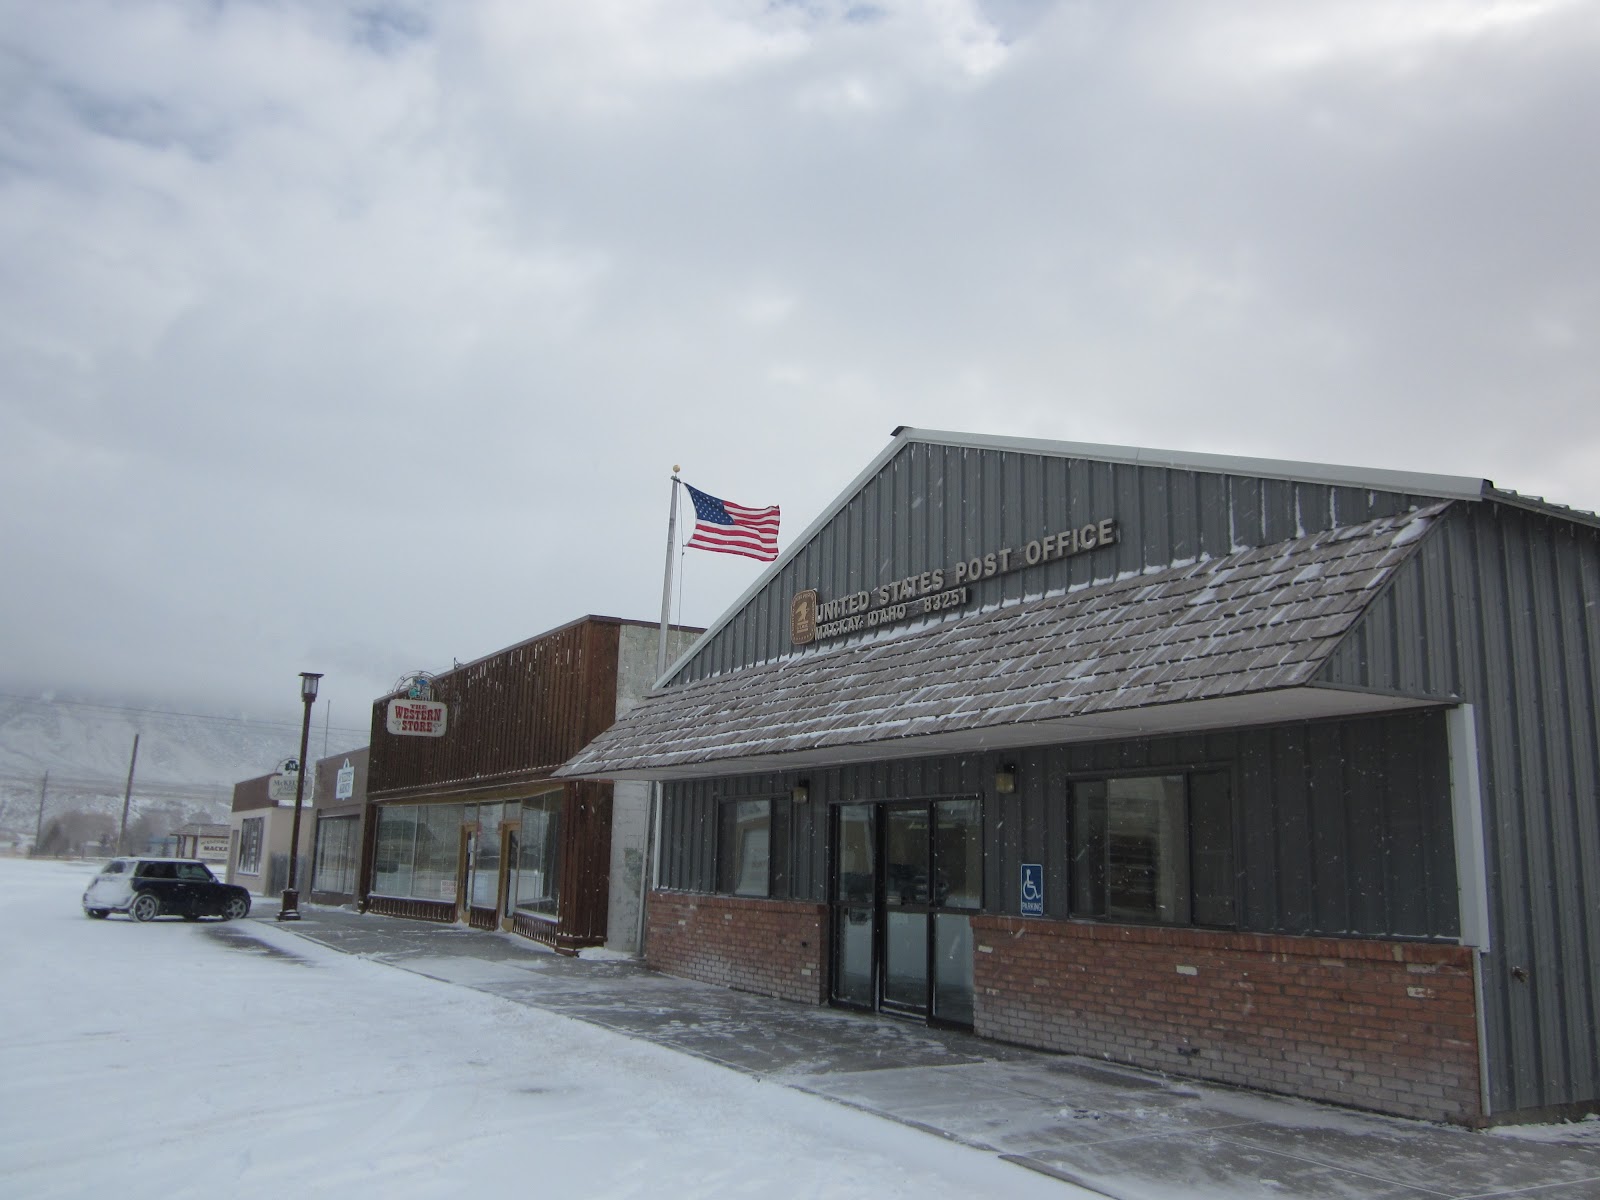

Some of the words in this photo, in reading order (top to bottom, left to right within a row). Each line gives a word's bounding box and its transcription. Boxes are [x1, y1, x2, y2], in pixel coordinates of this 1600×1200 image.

[815, 590, 869, 623] UNITED
[880, 568, 944, 605] STATES
[955, 548, 1012, 585] POST
[1026, 518, 1115, 565] OFFICE
[868, 604, 906, 627] IDAHO
[924, 587, 967, 612] 83251
[395, 705, 442, 721] WESTERN
[402, 720, 433, 732] STORE
[1022, 902, 1042, 911] PARKING
